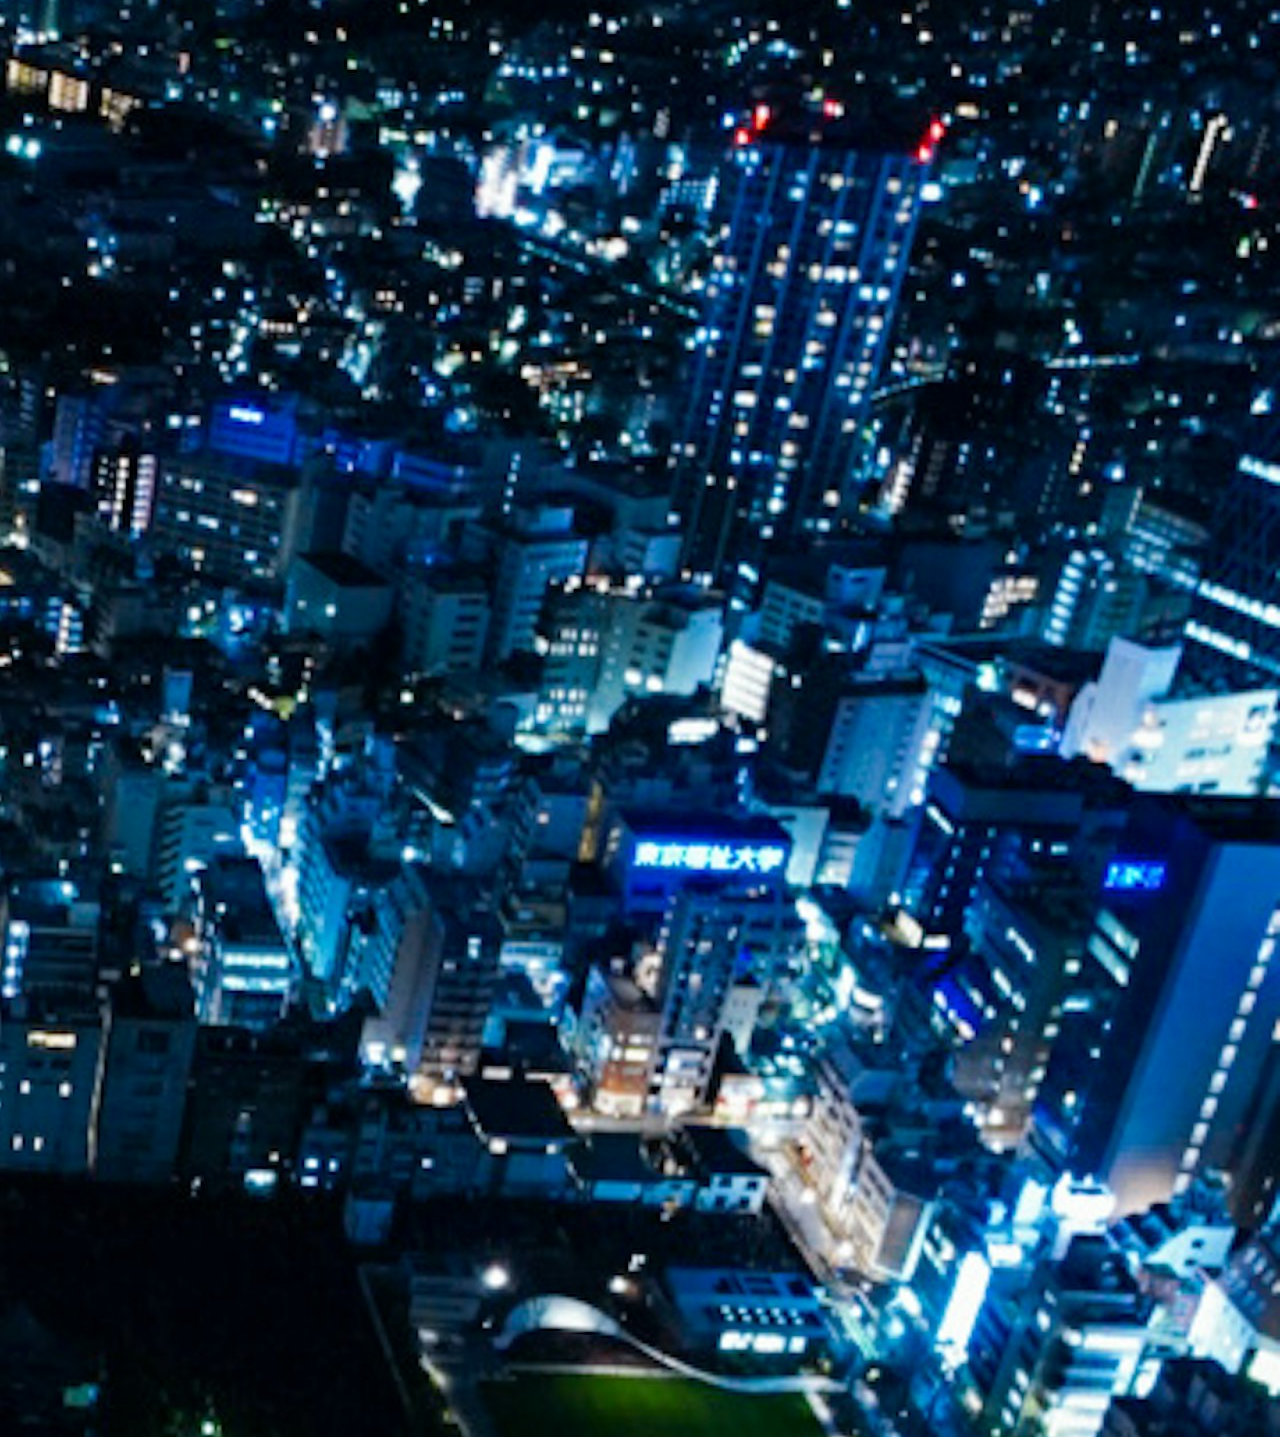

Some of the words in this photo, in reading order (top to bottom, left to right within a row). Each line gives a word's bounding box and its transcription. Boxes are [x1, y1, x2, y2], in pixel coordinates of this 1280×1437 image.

[635, 841, 784, 873] 東京福祉大学
